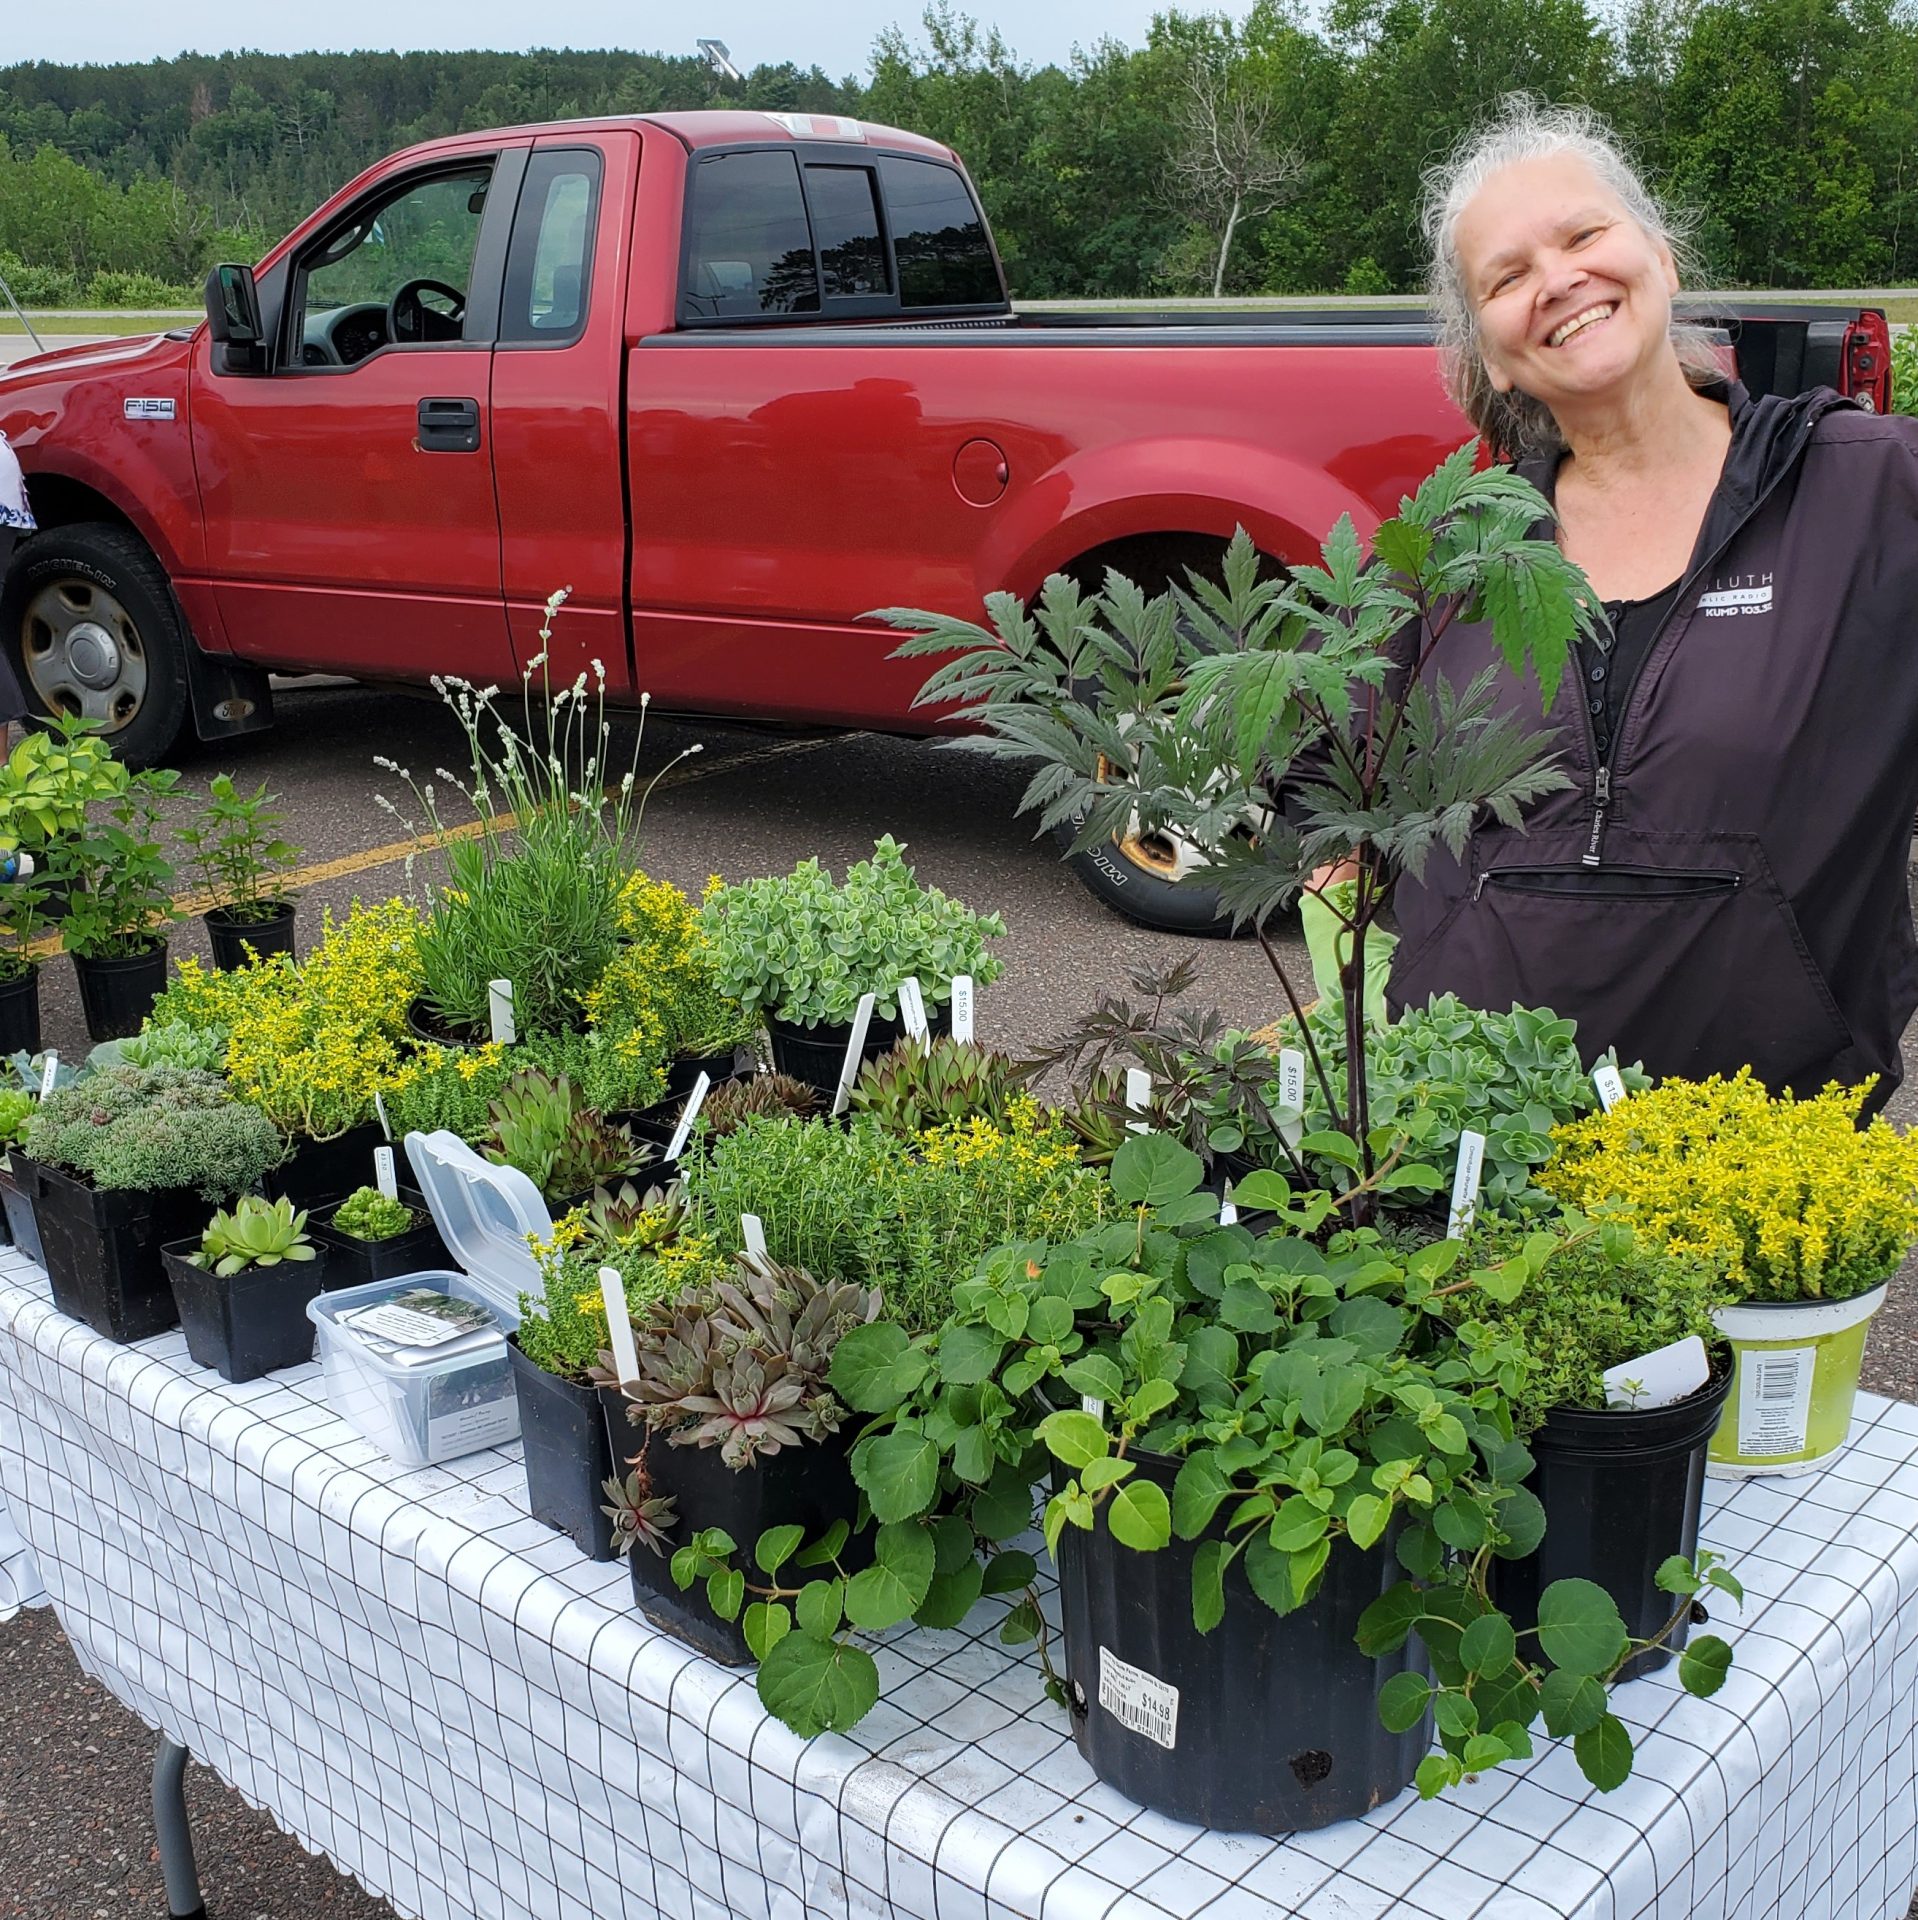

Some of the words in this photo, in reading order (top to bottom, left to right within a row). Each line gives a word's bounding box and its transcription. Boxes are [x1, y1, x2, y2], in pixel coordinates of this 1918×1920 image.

[27, 557, 117, 589] MICHELIN
[1732, 592, 1767, 601] RADIO
[1705, 606, 1739, 617] KUMD
[1589, 834, 1600, 853] River
[958, 990, 968, 1022] $15.00
[1287, 1066, 1297, 1102] $15.00
[1141, 1692, 1170, 1721] $14.98
